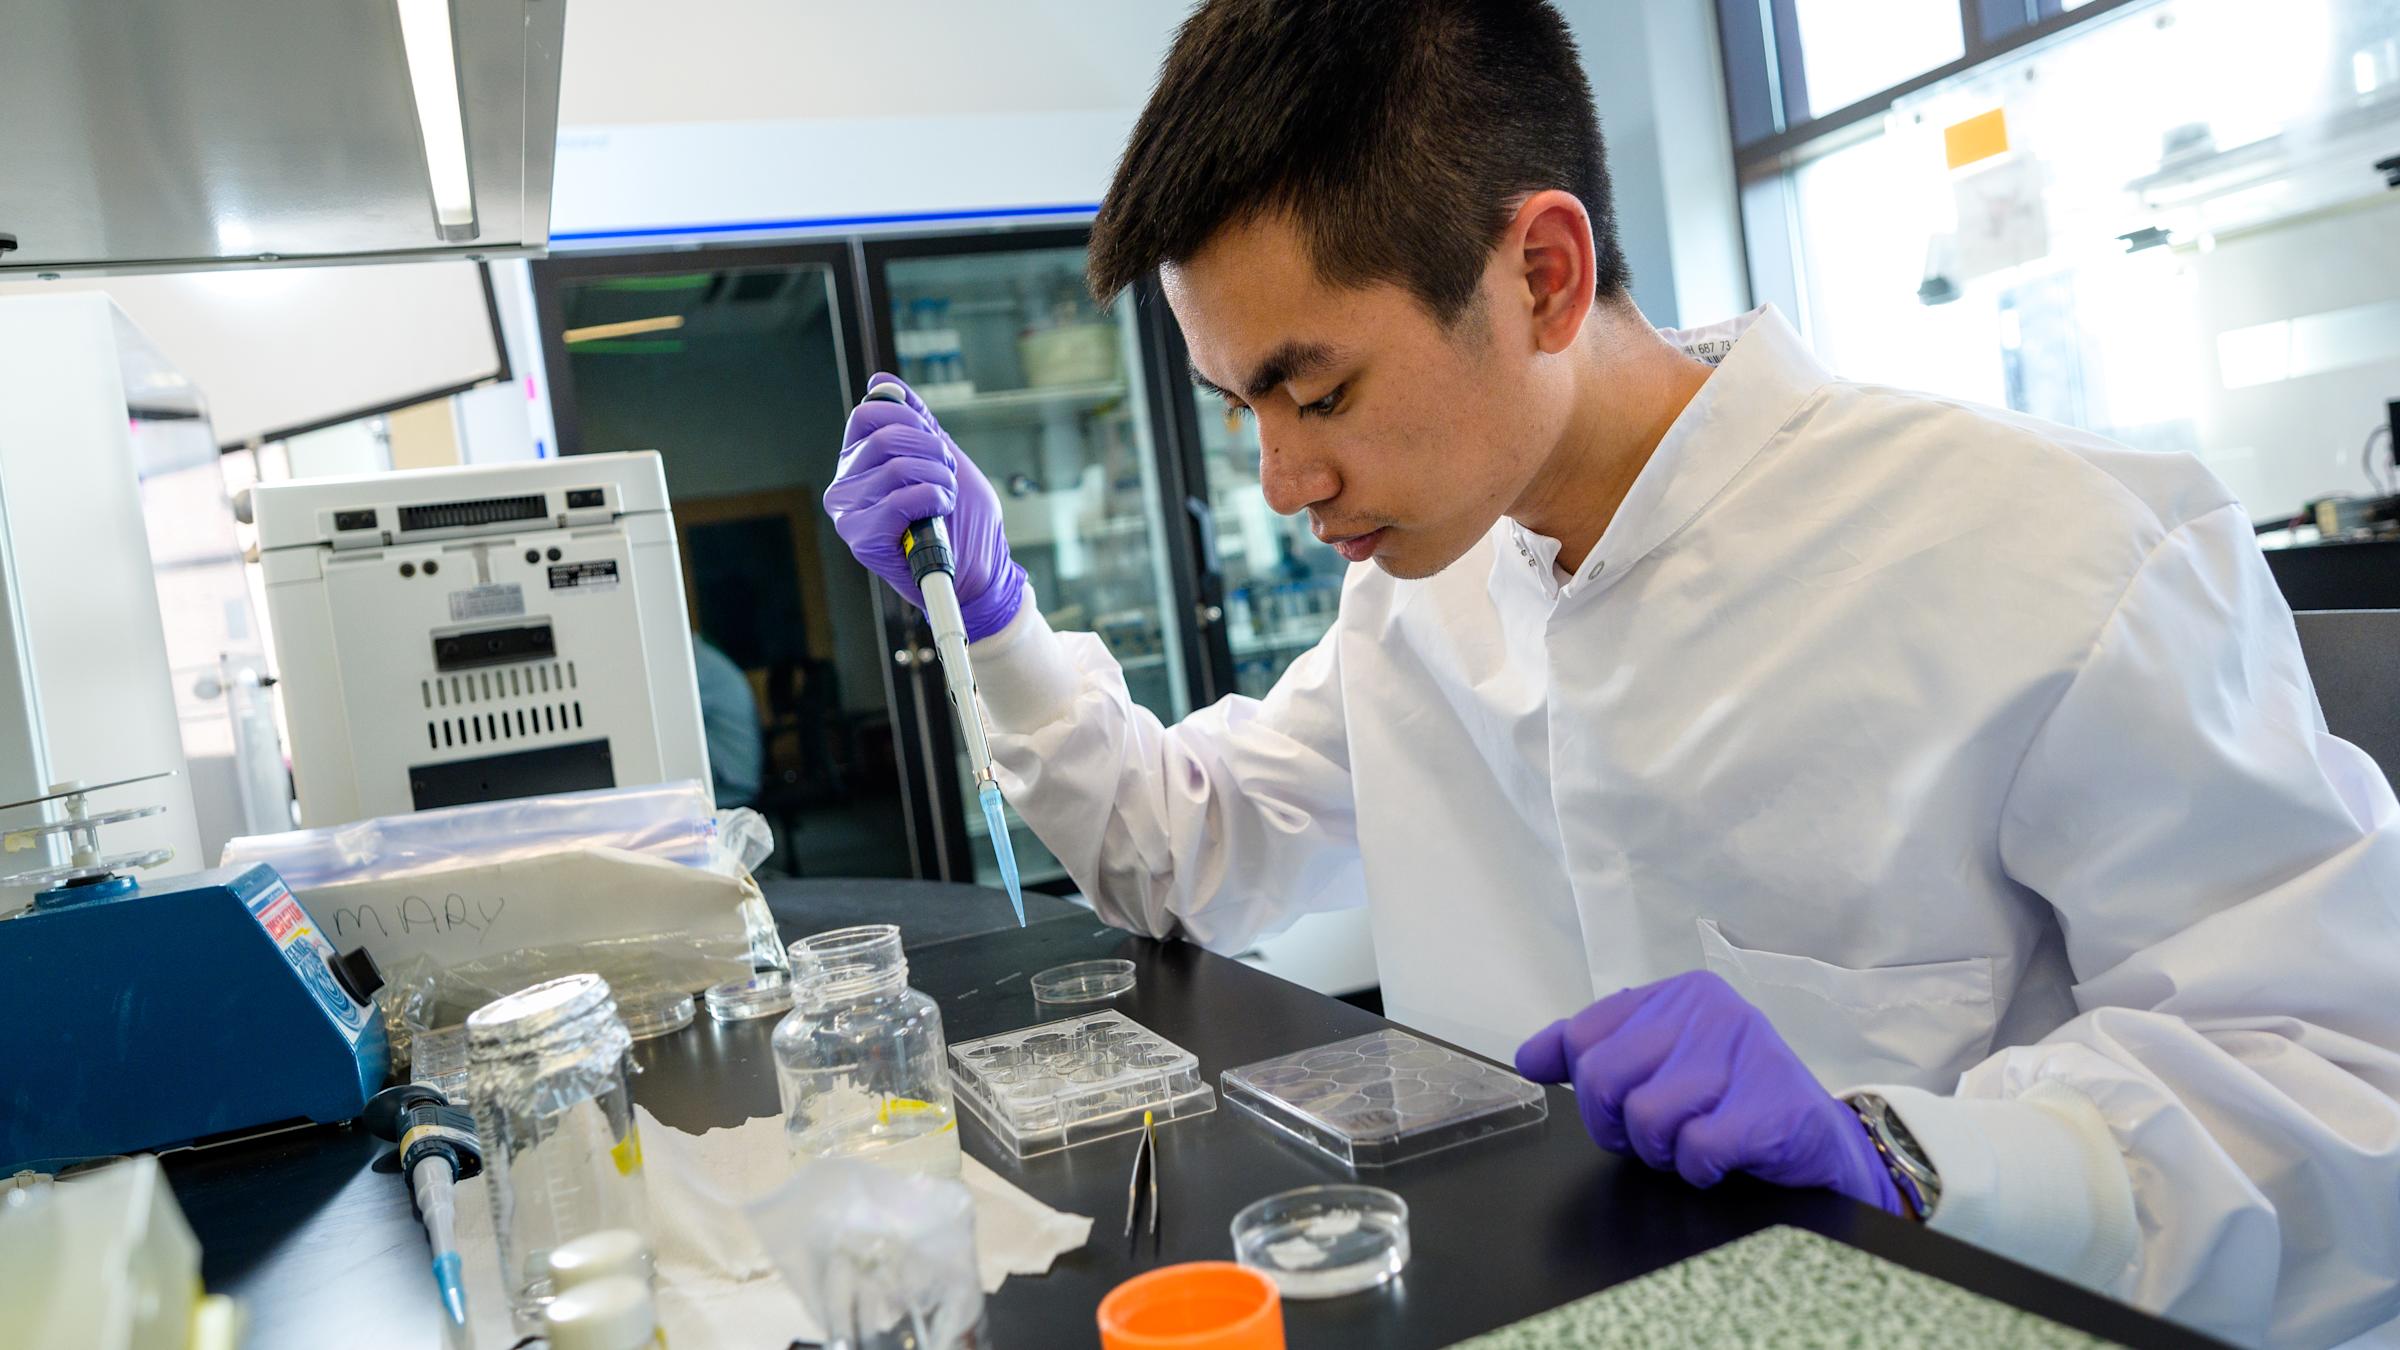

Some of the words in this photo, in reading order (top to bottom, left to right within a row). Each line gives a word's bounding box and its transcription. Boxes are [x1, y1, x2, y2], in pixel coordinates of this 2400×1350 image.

[1698, 342, 1714, 354] 687
[1720, 340, 1731, 351] 73
[333, 893, 504, 944] MARY
